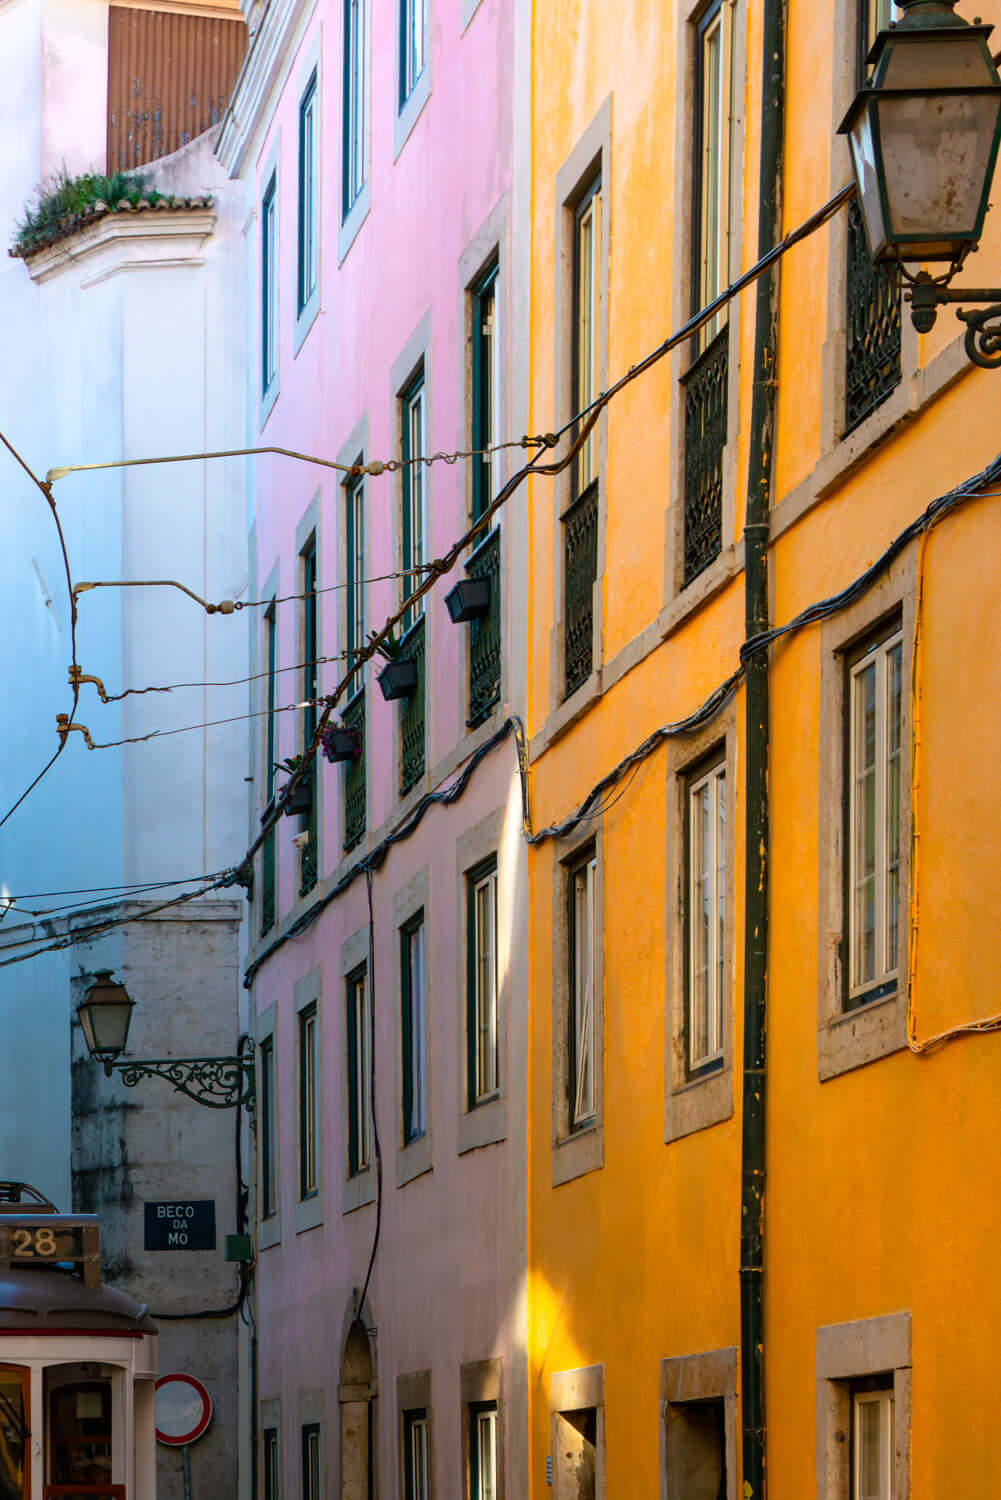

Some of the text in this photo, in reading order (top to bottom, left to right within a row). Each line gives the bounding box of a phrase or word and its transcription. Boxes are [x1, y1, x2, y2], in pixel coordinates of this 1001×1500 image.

[157, 1206, 194, 1218] BECO
[172, 1219, 188, 1229] DA
[12, 1228, 56, 1257] 28
